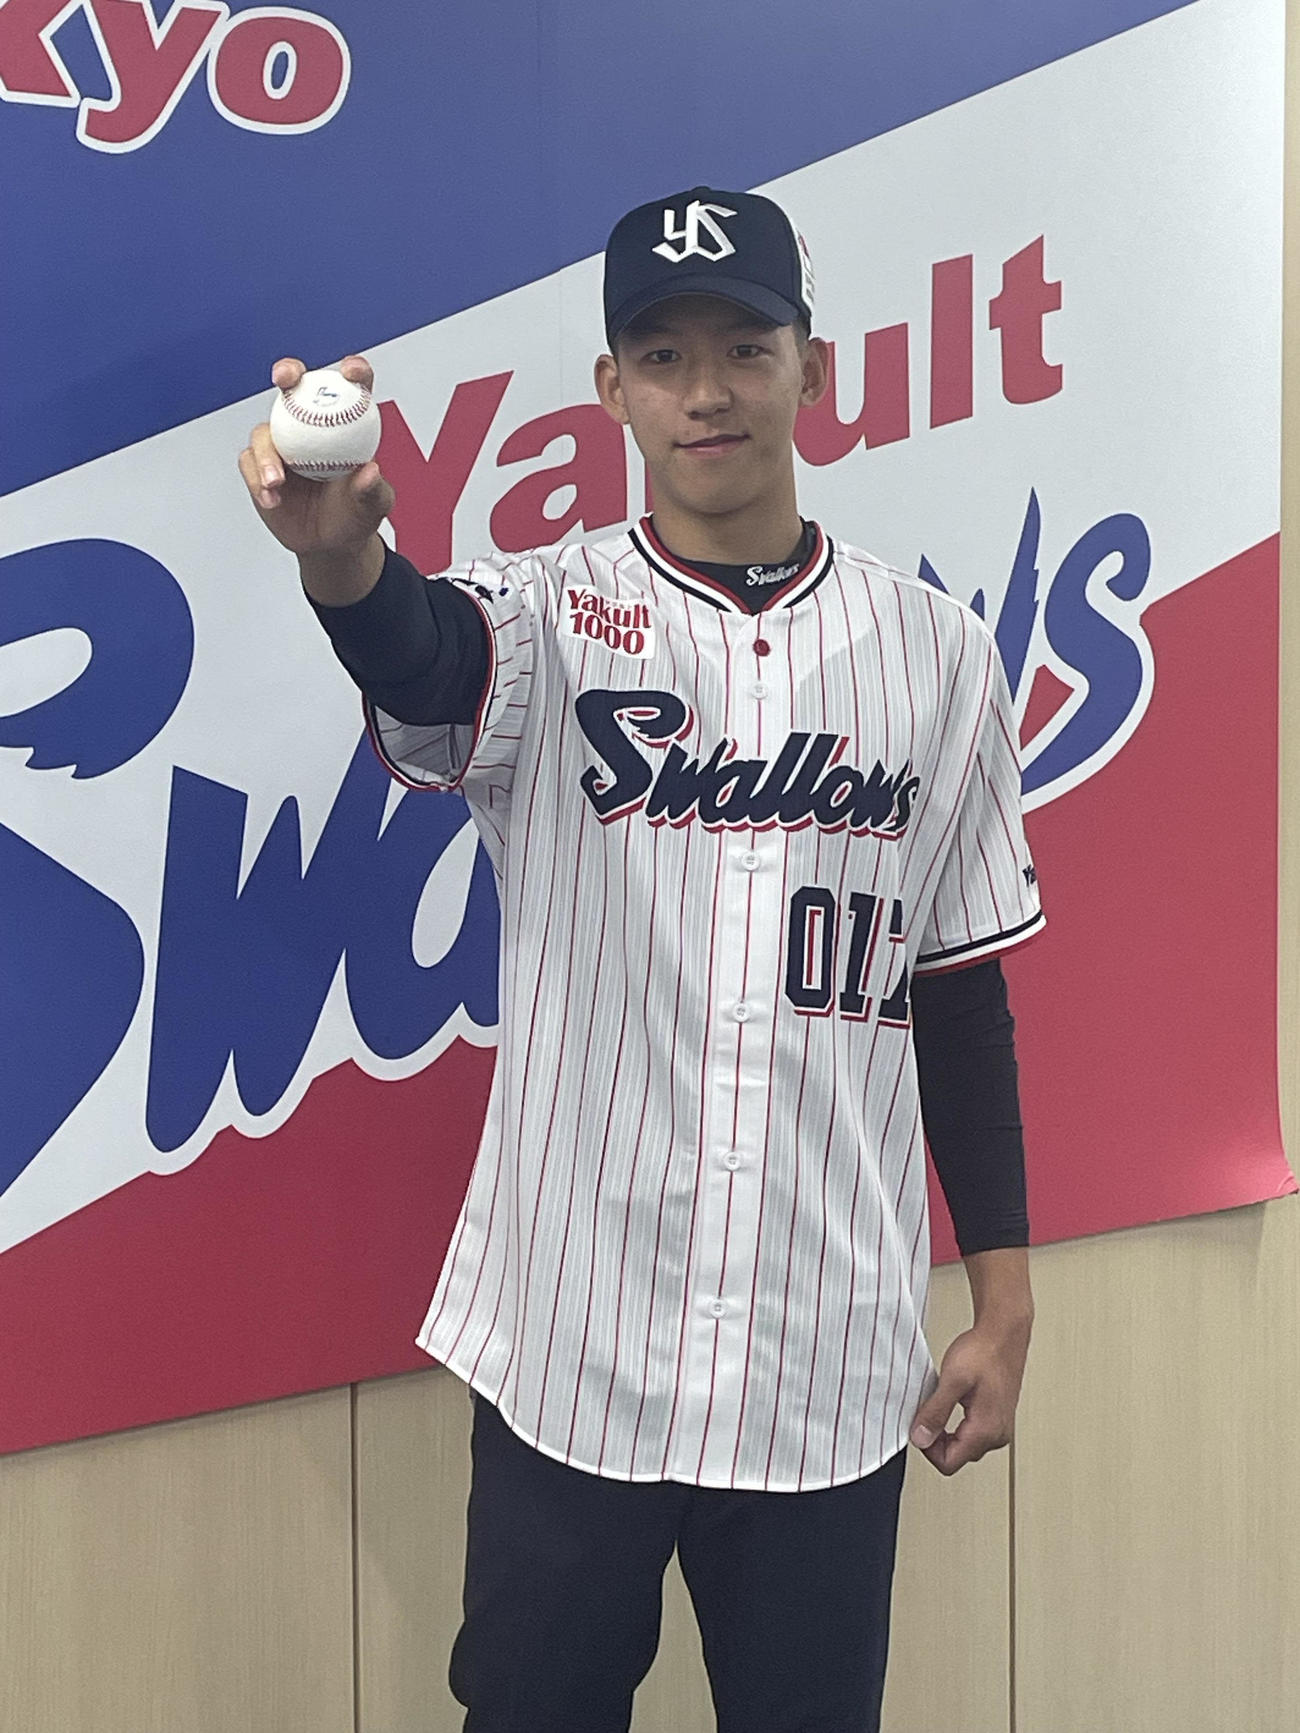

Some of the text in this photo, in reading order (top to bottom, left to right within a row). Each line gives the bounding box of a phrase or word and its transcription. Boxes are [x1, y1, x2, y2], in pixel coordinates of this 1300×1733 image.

[376, 234, 1063, 576] Yault
[567, 588, 652, 629] Yakult
[569, 611, 645, 655] 1000
[574, 688, 919, 839] Swallows
